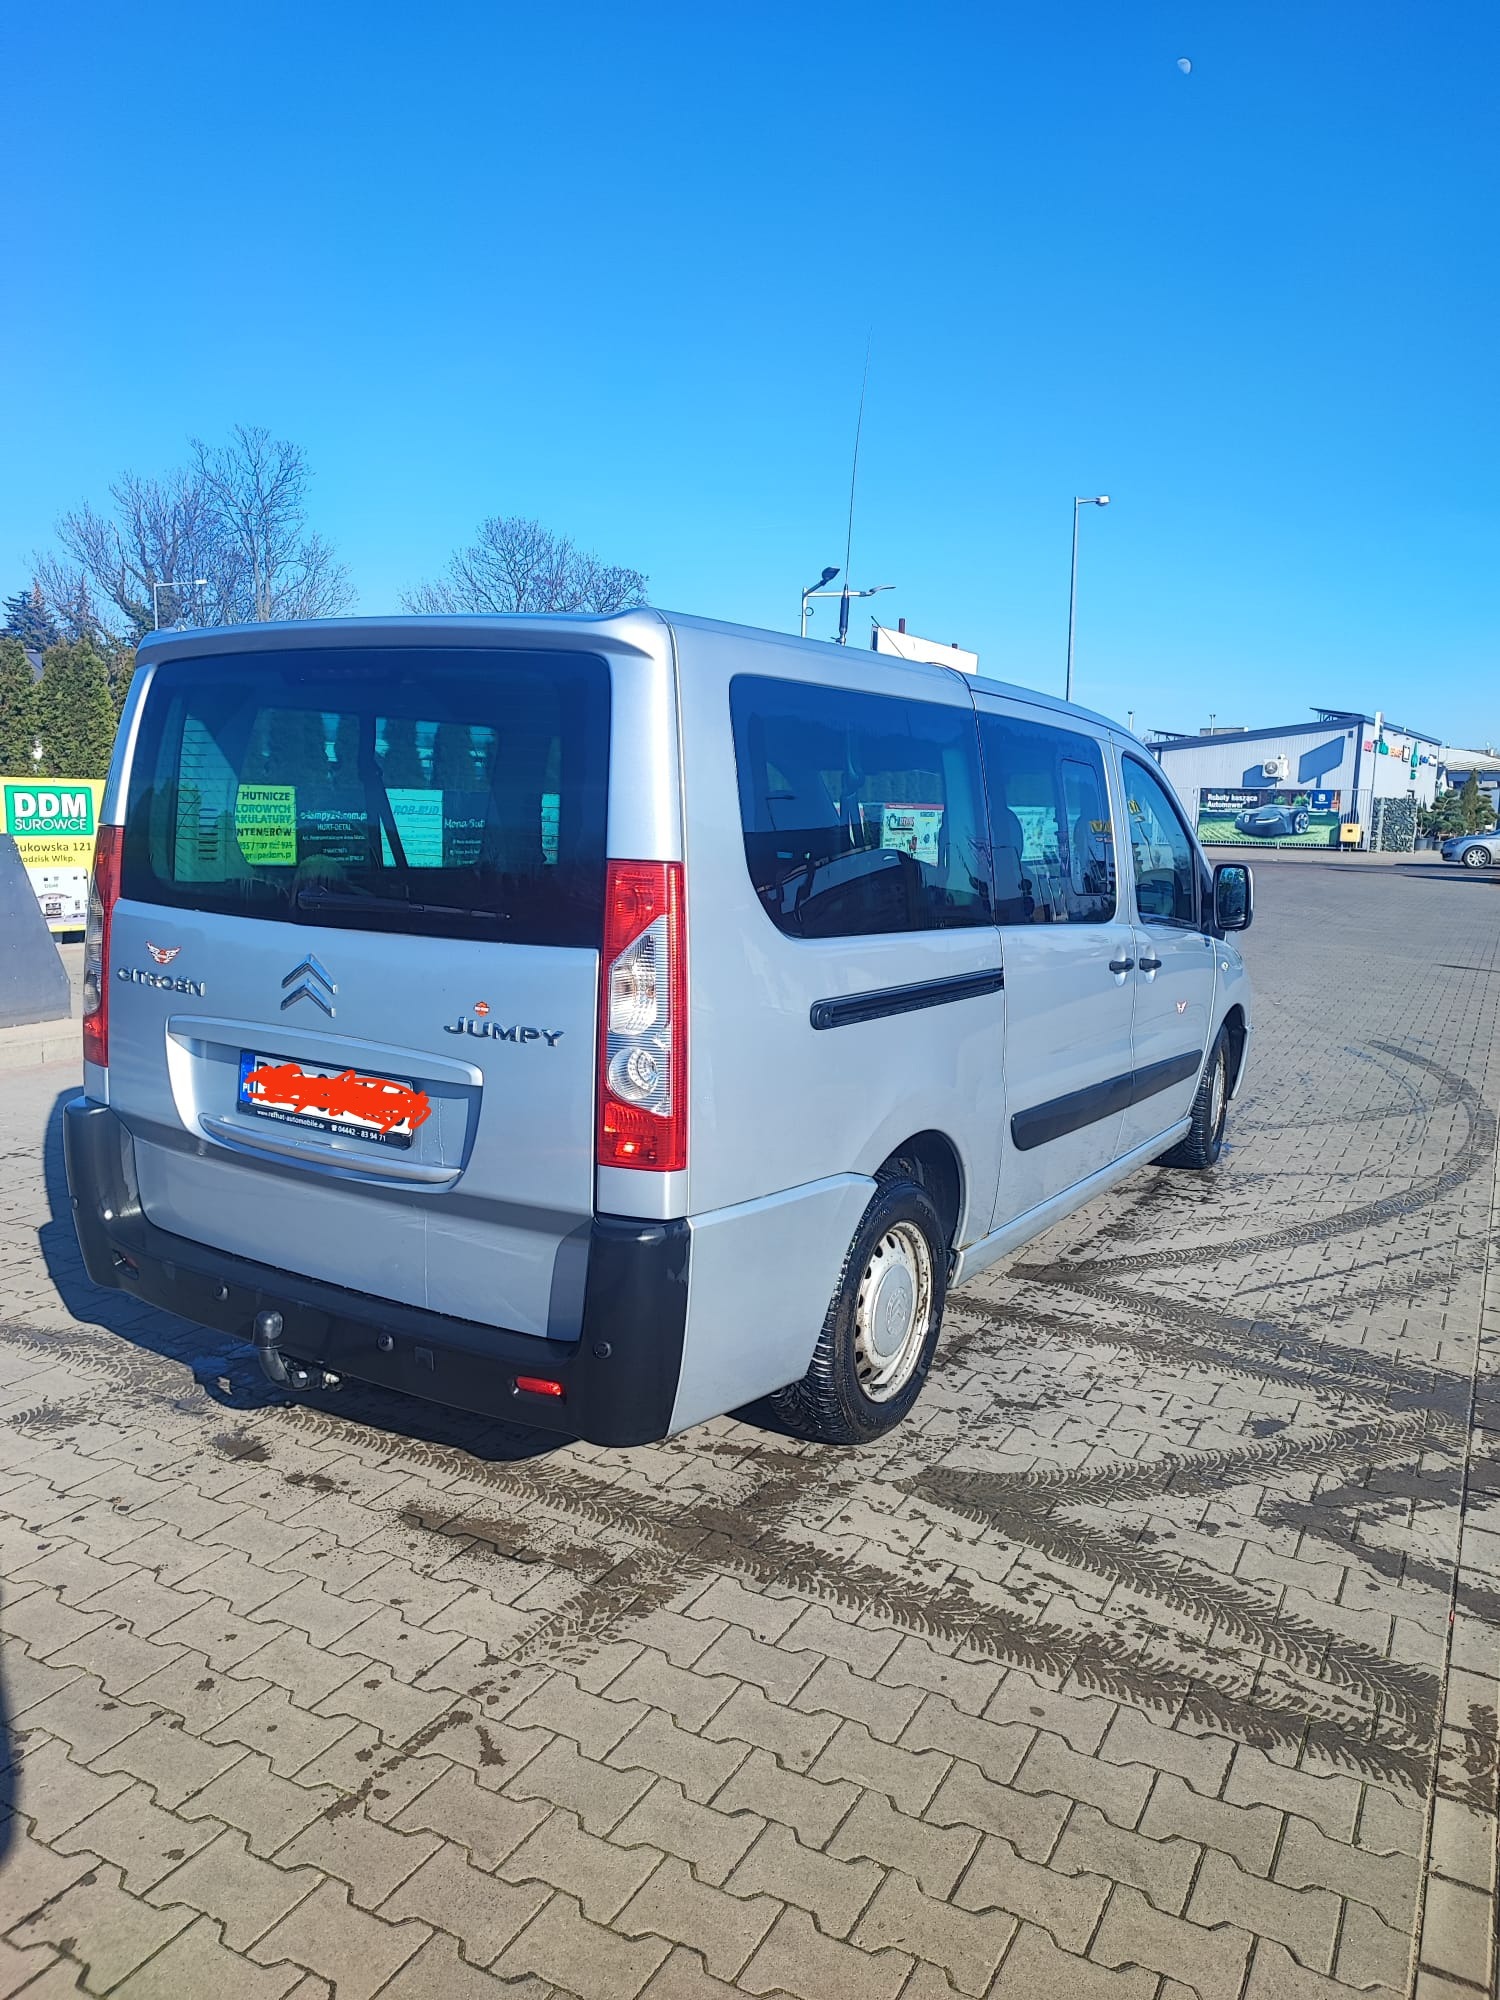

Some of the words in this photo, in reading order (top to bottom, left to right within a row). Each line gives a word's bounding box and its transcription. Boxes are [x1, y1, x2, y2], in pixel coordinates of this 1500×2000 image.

[242, 792, 291, 801] HUTNICZE
[1207, 793, 1230, 802] Roboty
[13, 792, 87, 818] DDM
[14, 818, 87, 831] SUROWCE
[17, 842, 69, 852] ukowska
[73, 842, 91, 851] 121
[21, 855, 50, 863] odzisk
[52, 855, 76, 863] Wlkp.
[443, 1015, 565, 1047] JUMPY
[242, 1082, 252, 1094] PL
[337, 1126, 356, 1136] 04442
[361, 1130, 369, 1138] 83
[370, 1132, 379, 1140] 94
[379, 1133, 387, 1142] 71
